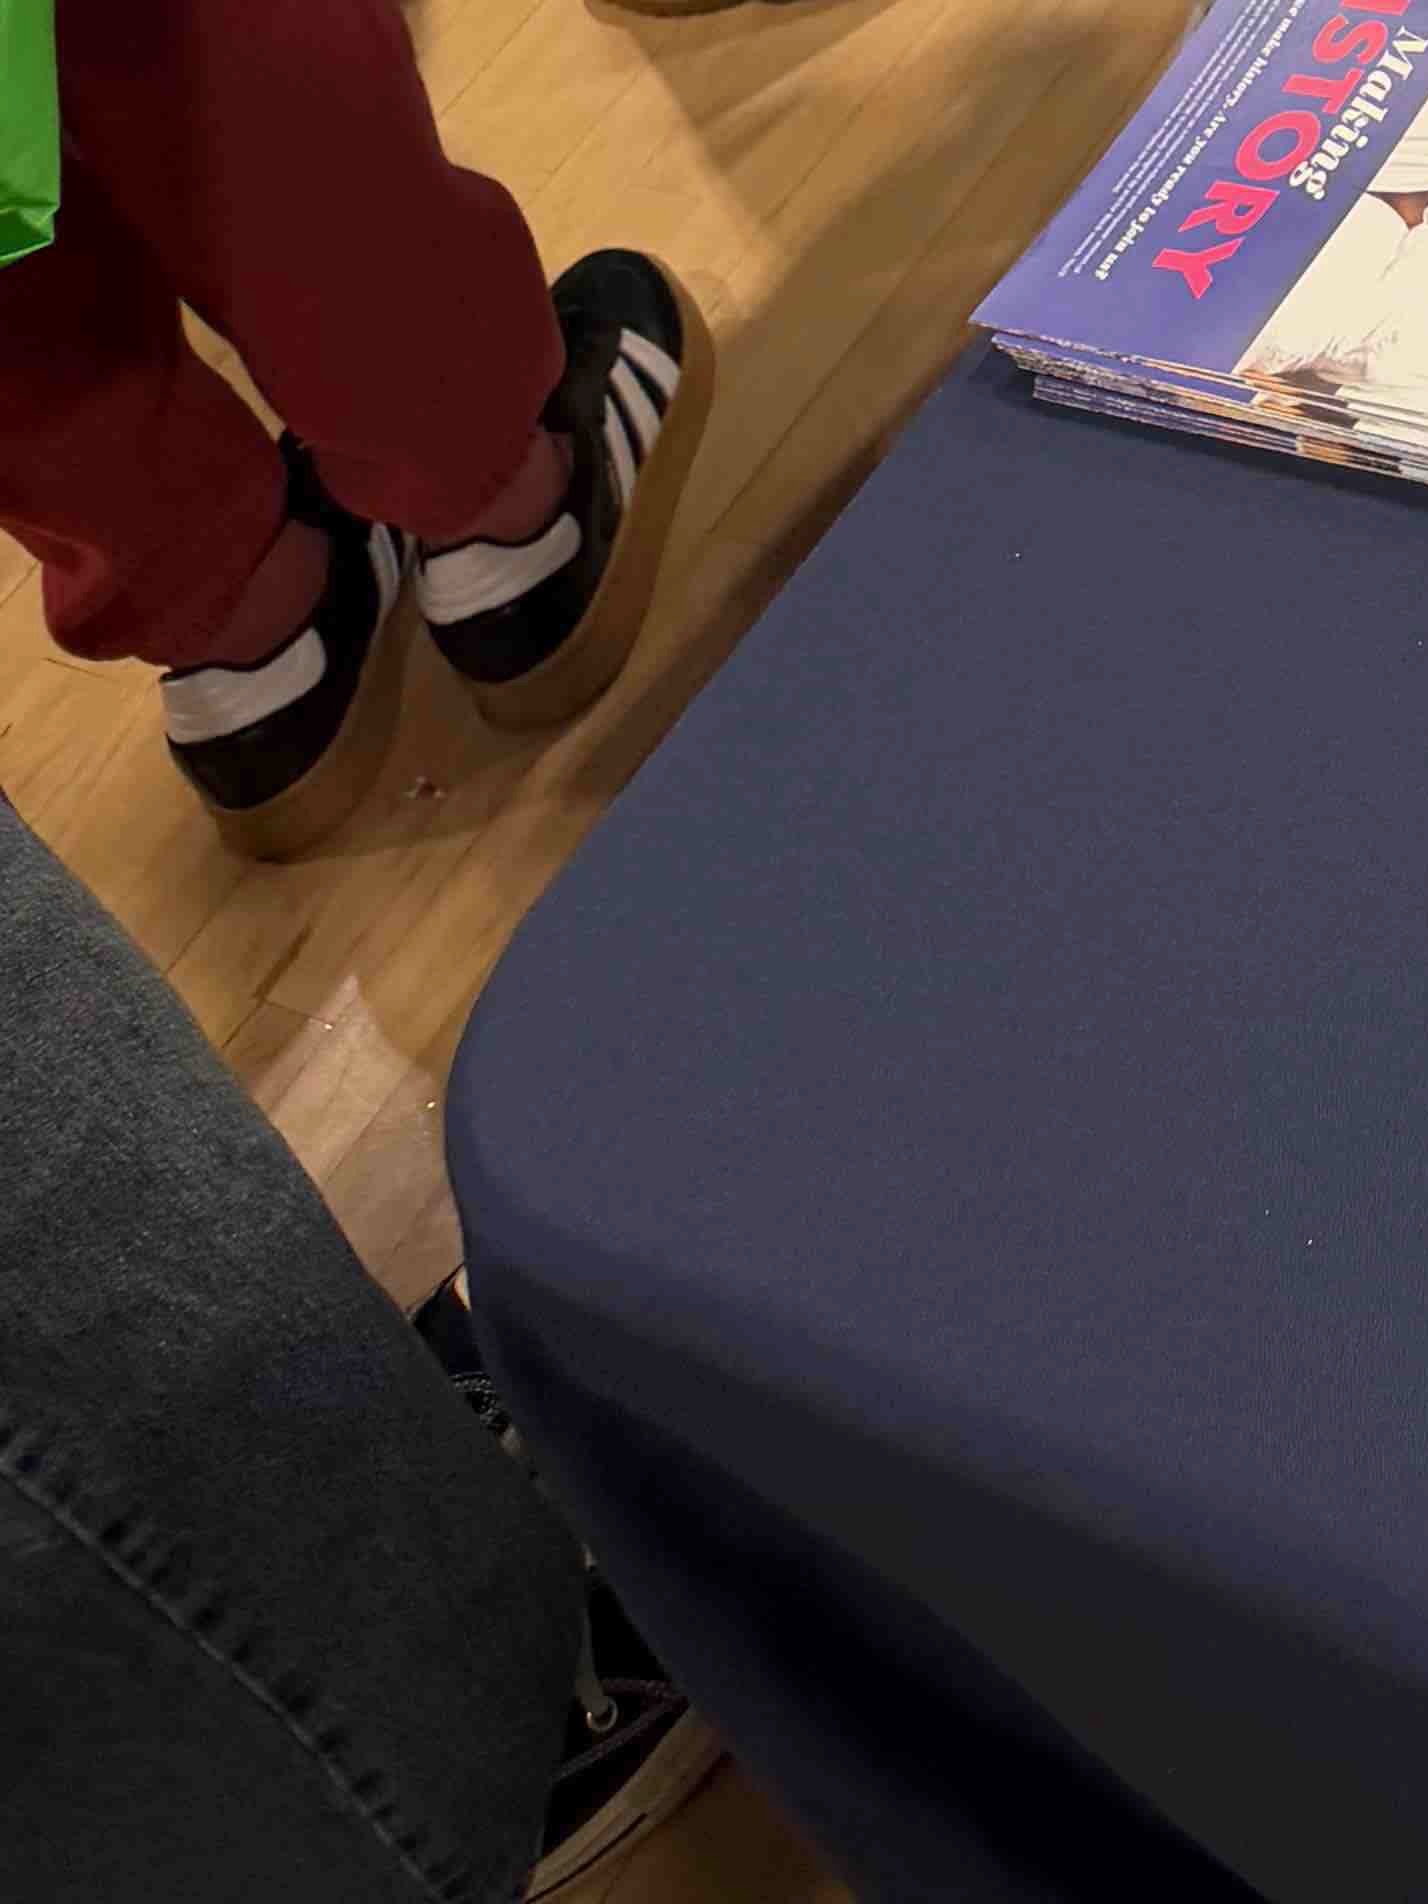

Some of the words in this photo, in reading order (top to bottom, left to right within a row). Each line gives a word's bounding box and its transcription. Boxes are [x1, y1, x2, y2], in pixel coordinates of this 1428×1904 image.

[1261, 17, 1291, 56] make
[1203, 111, 1225, 137] Are
[1183, 136, 1207, 164] you
[1151, 165, 1186, 205] ready
[1114, 219, 1144, 252] join
